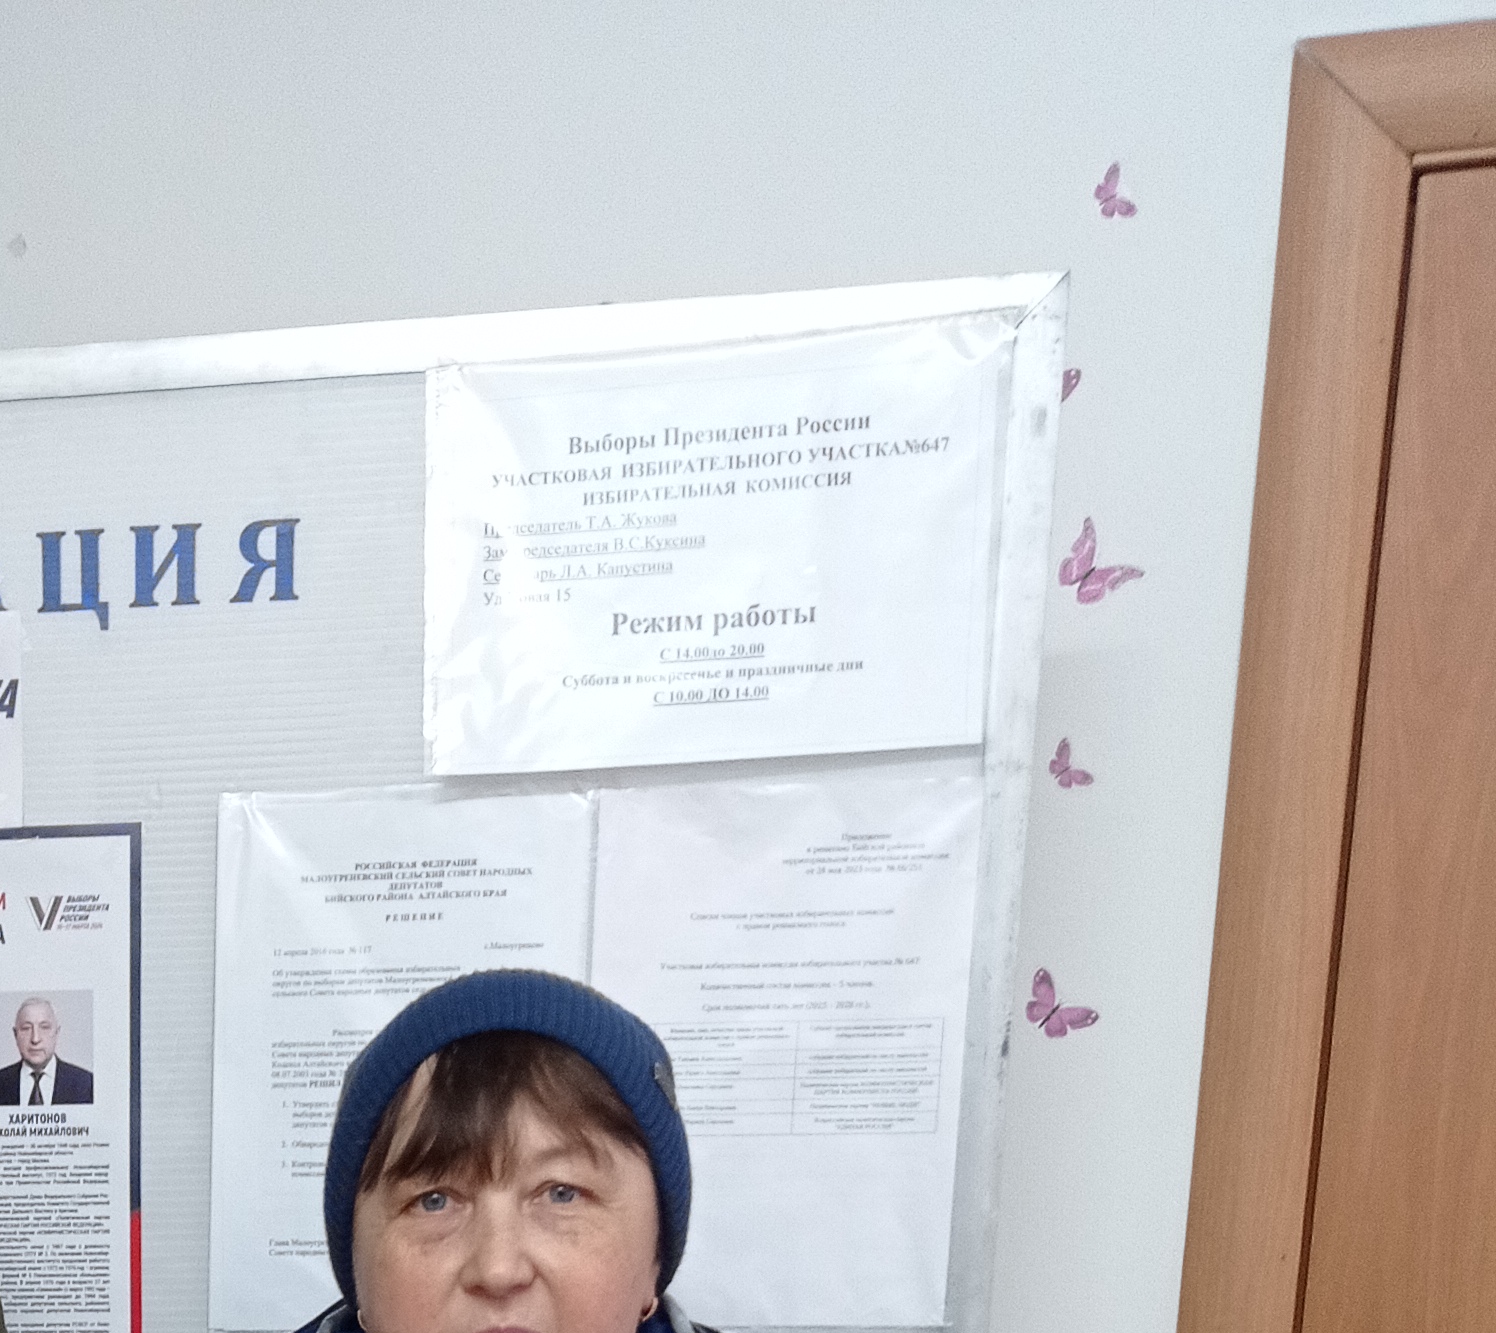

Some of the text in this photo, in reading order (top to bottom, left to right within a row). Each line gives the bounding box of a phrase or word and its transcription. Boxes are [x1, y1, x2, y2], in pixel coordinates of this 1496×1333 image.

[568, 414, 871, 456] Выборы Президента России
[491, 465, 613, 488] УЧАСТКОВАЯ
[620, 450, 802, 479] ИЗБИРАТЕЛЬНОГО
[582, 470, 853, 506] ИЗБИРАТЕЛЬНАЯ КОМИССИЯ
[621, 511, 678, 529] Жукова
[596, 560, 673, 578] Капустина
[555, 587, 572, 603] 15
[611, 603, 817, 637] Режим работы
[659, 647, 670, 661] С
[675, 646, 710, 660] 14.00
[729, 642, 765, 658] 20.00
[561, 673, 620, 690] Суббота
[623, 674, 632, 685] и
[725, 668, 734, 679] и
[738, 660, 834, 680] праздничные
[836, 660, 864, 673] дни
[653, 685, 769, 704] С 10.00 ДО 14.00
[354, 858, 478, 872] РОССИЙСКАЯ ФЕДЕРАЦИЯ
[447, 868, 478, 878] СОВЕТ
[479, 866, 534, 878] НАРОДНЫХ
[388, 881, 443, 892] ДЕПУТАТОВ
[63, 903, 110, 913] ПРЕЗИДЕНТА
[59, 913, 90, 923] РОССИИ
[8, 1112, 67, 1124] ХАРИТОНОВ
[29, 1125, 90, 1137] МИХАЙЛОВИЧ
